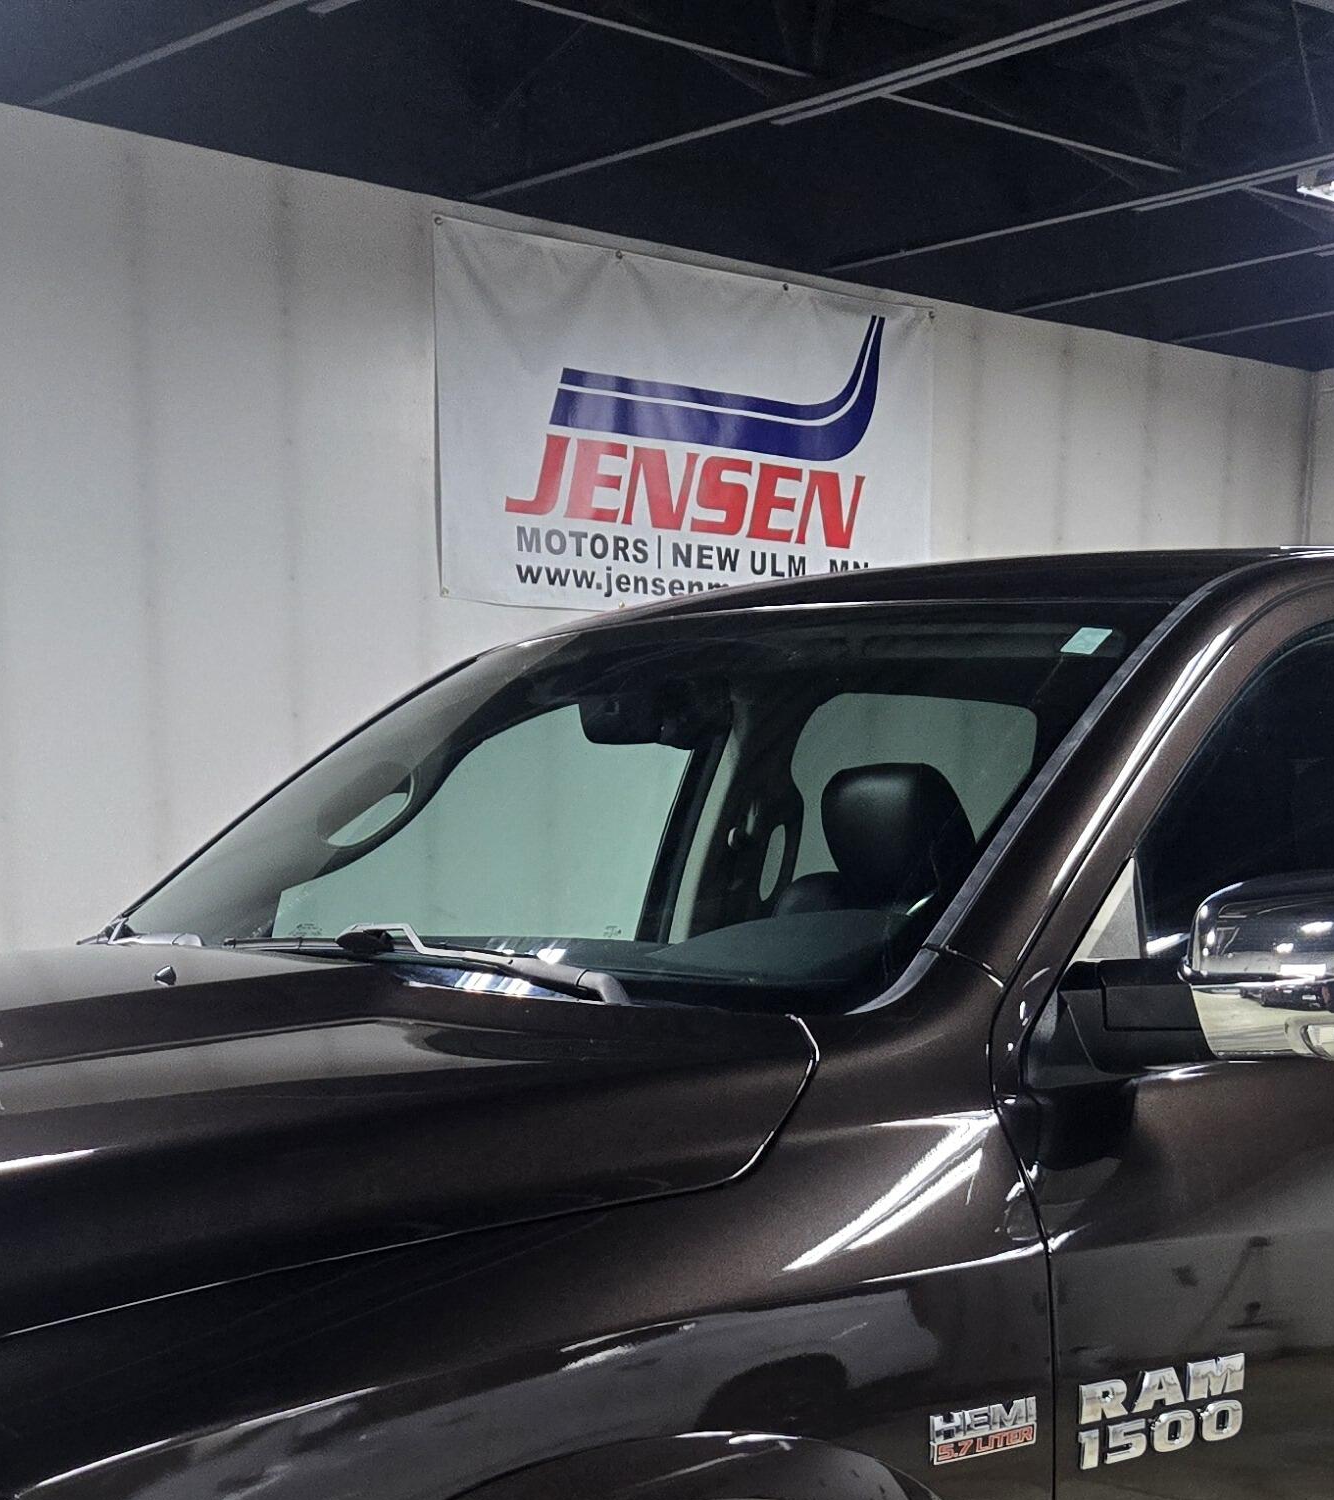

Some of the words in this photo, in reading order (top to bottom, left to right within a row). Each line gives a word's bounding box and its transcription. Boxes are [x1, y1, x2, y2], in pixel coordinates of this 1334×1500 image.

[504, 433, 866, 549] JENSEN
[516, 525, 650, 564] MOTORS
[672, 541, 740, 572] NEW
[750, 550, 806, 577] ULM
[930, 1396, 1036, 1442] HEMI
[1078, 1352, 1245, 1425] RAM
[937, 1440, 973, 1461] 5.7
[975, 1426, 1033, 1453] LITER
[1078, 1399, 1244, 1470] 1500
